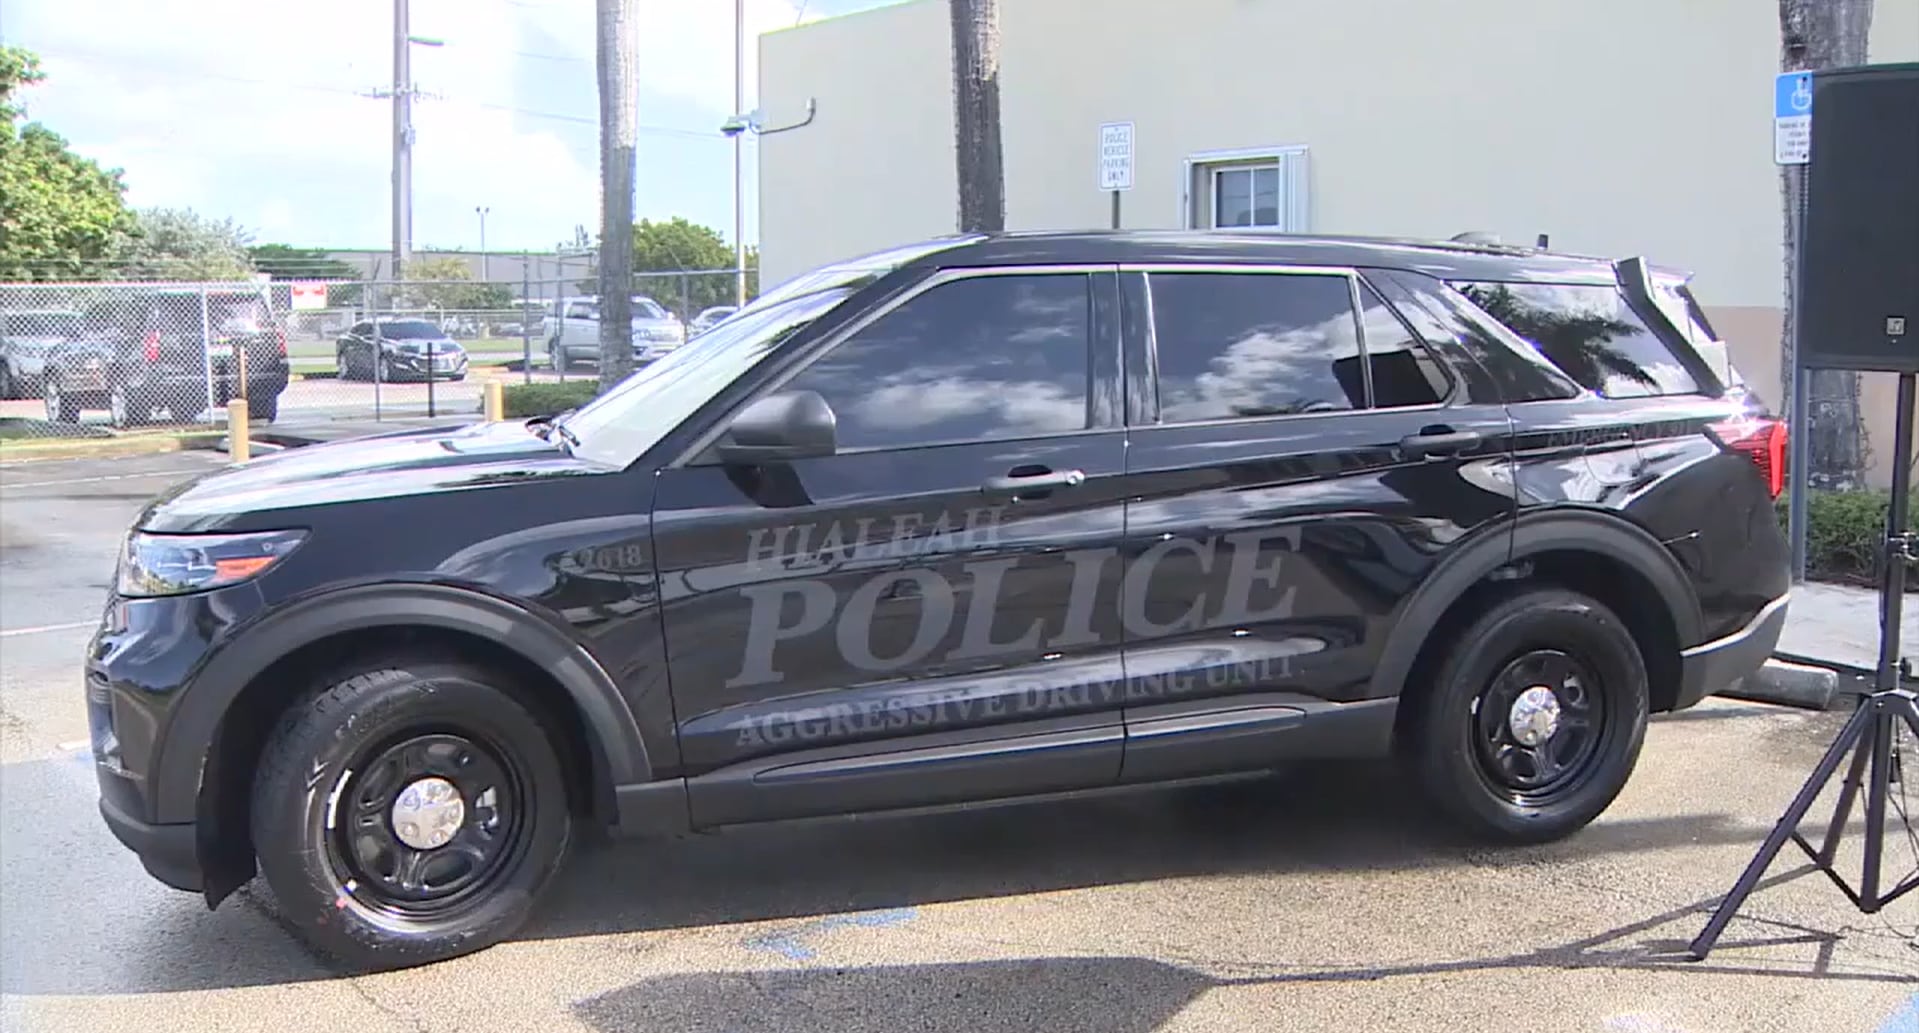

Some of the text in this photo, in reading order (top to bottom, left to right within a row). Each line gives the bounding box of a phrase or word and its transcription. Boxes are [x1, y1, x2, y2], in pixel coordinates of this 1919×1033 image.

[1107, 170, 1125, 182] ONLY
[743, 504, 1010, 573] HIALEAH
[725, 526, 1303, 689] POLICE
[735, 656, 1292, 748] AGGRESSIVE DRIVING UNIT
